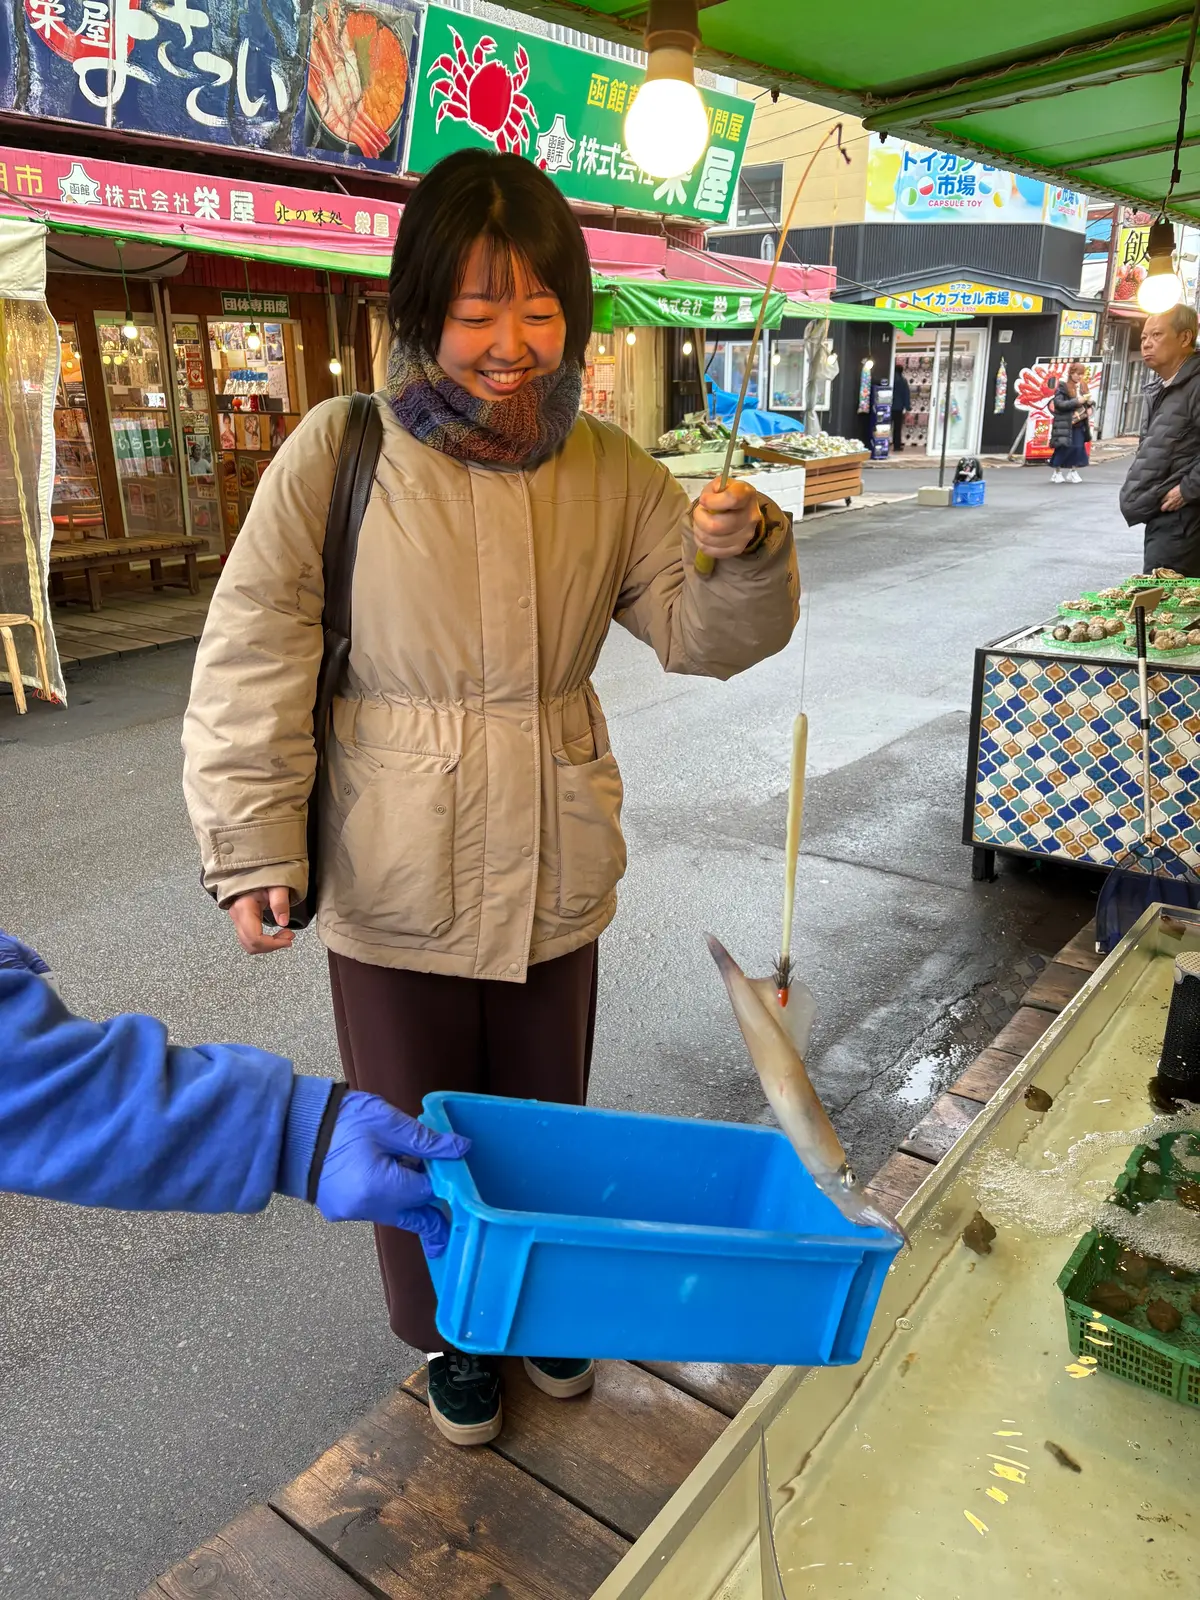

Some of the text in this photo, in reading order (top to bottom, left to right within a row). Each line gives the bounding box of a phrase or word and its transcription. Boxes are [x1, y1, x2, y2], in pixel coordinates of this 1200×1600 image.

[30, 0, 109, 48] 栄屋
[937, 175, 976, 196] 市場
[69, 183, 90, 196] 函館
[276, 204, 343, 226] 北の味処
[354, 211, 390, 237] 栄屋
[928, 199, 982, 207] CAPSULE TOY
[223, 297, 288, 314] 団体専用席
[911, 290, 1011, 306] トイカプセル市場
